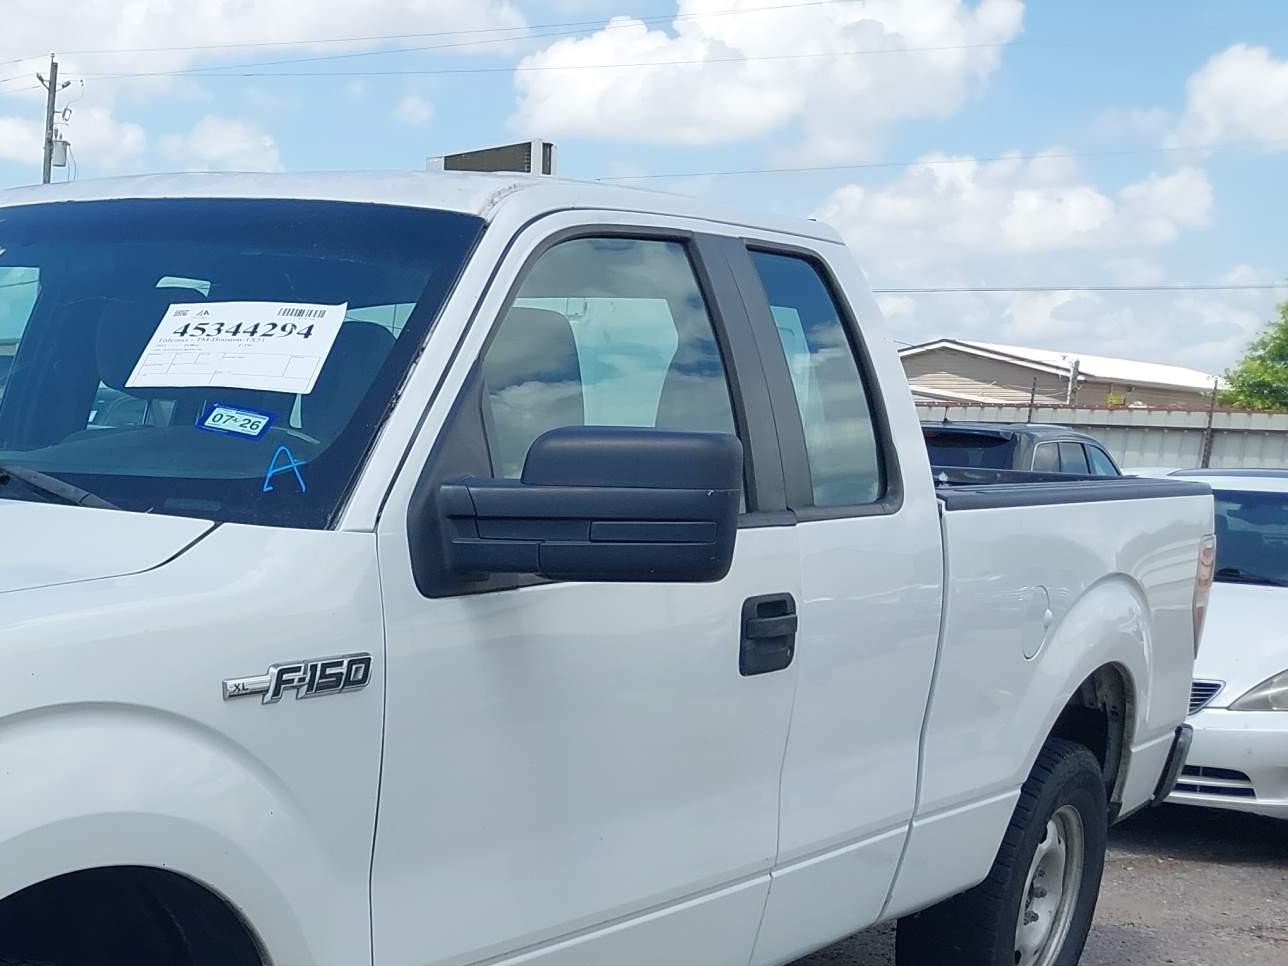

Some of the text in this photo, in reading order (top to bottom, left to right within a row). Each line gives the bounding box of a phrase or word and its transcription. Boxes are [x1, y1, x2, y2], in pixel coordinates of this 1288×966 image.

[173, 322, 314, 338] 45344294
[212, 413, 235, 425] 07
[239, 418, 262, 431] 26
[263, 446, 307, 493] A
[232, 654, 373, 704] XL F-150
